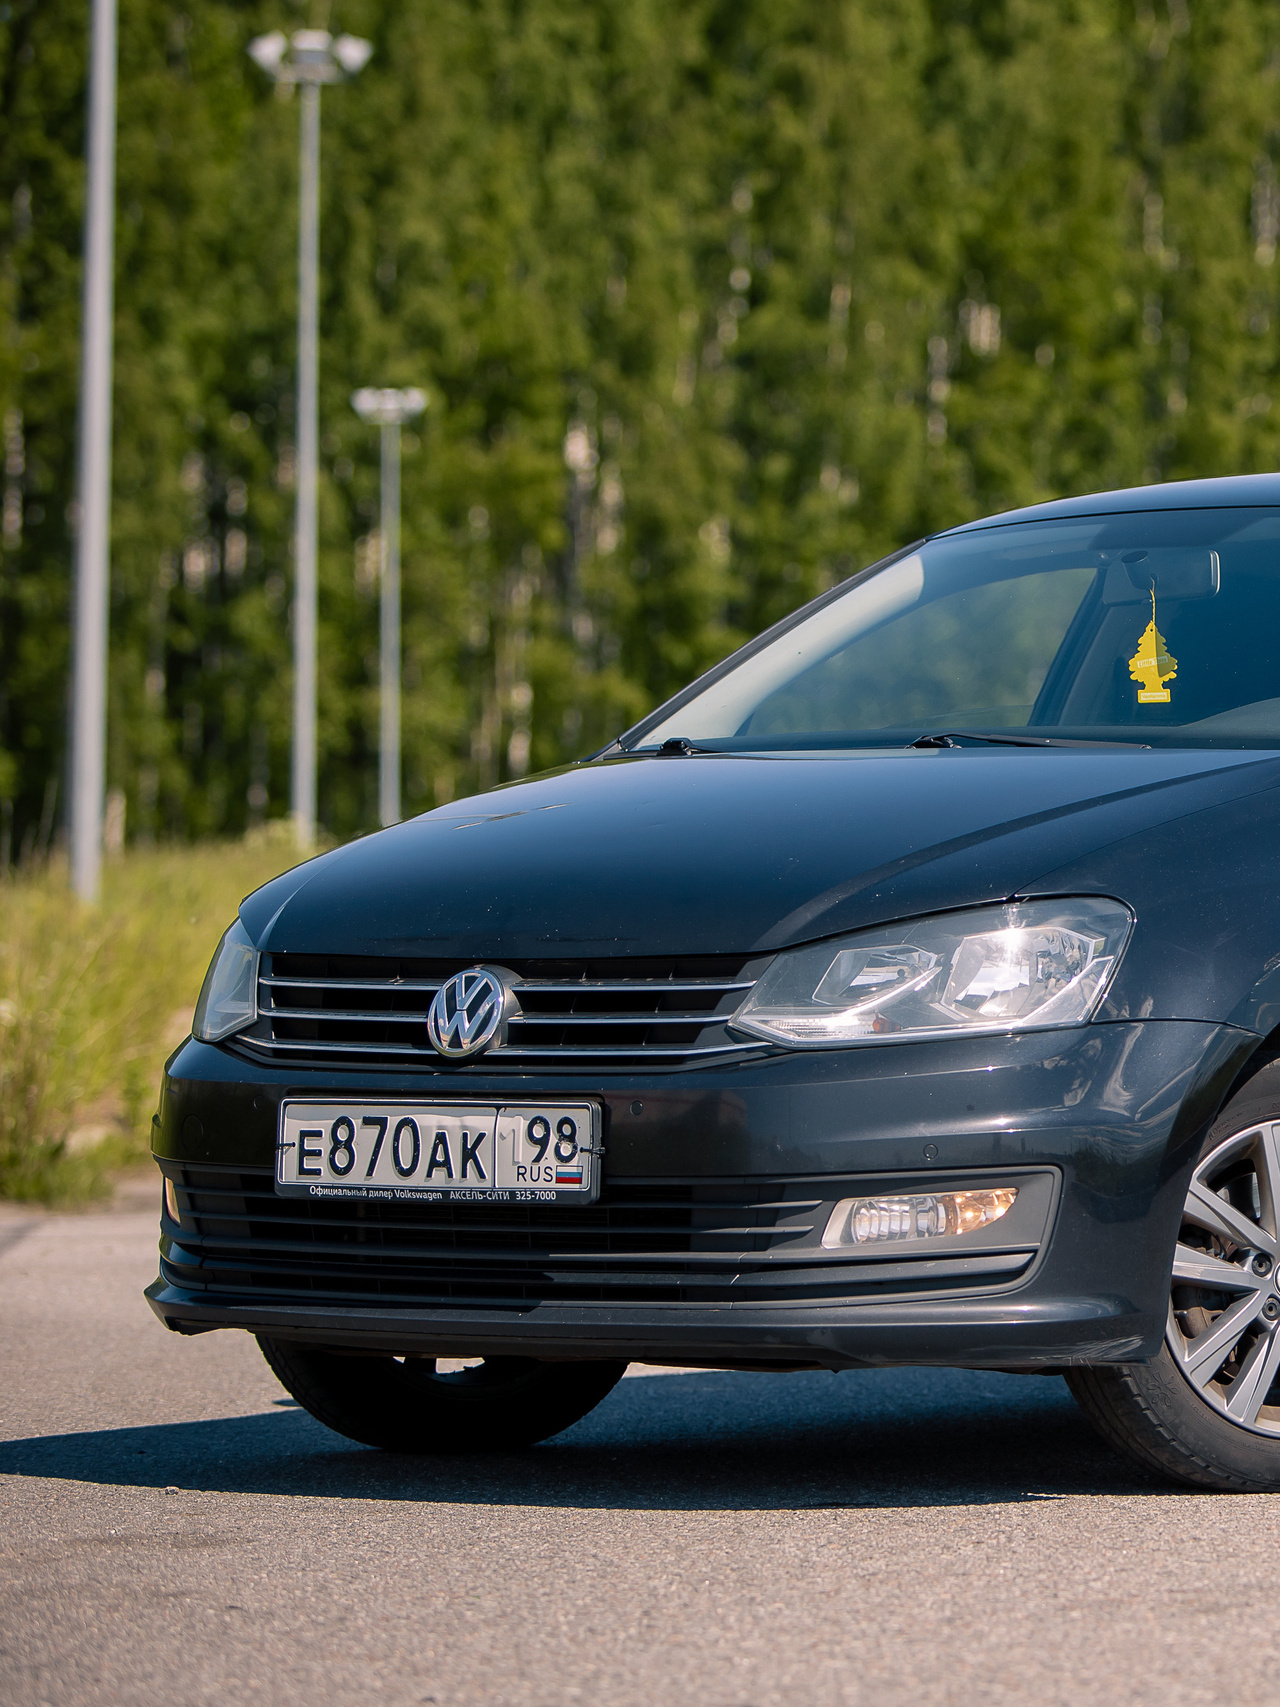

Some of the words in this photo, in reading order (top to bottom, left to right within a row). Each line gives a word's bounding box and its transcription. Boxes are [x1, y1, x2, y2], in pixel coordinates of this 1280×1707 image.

[516, 1166, 553, 1183] RUS
[309, 1185, 368, 1197] Официальный
[368, 1189, 393, 1199] дилер
[394, 1189, 443, 1200] Volkswagen
[450, 1191, 510, 1200] АКСЕЛЬ-СИТИ
[515, 1191, 557, 1201] 325-7000
